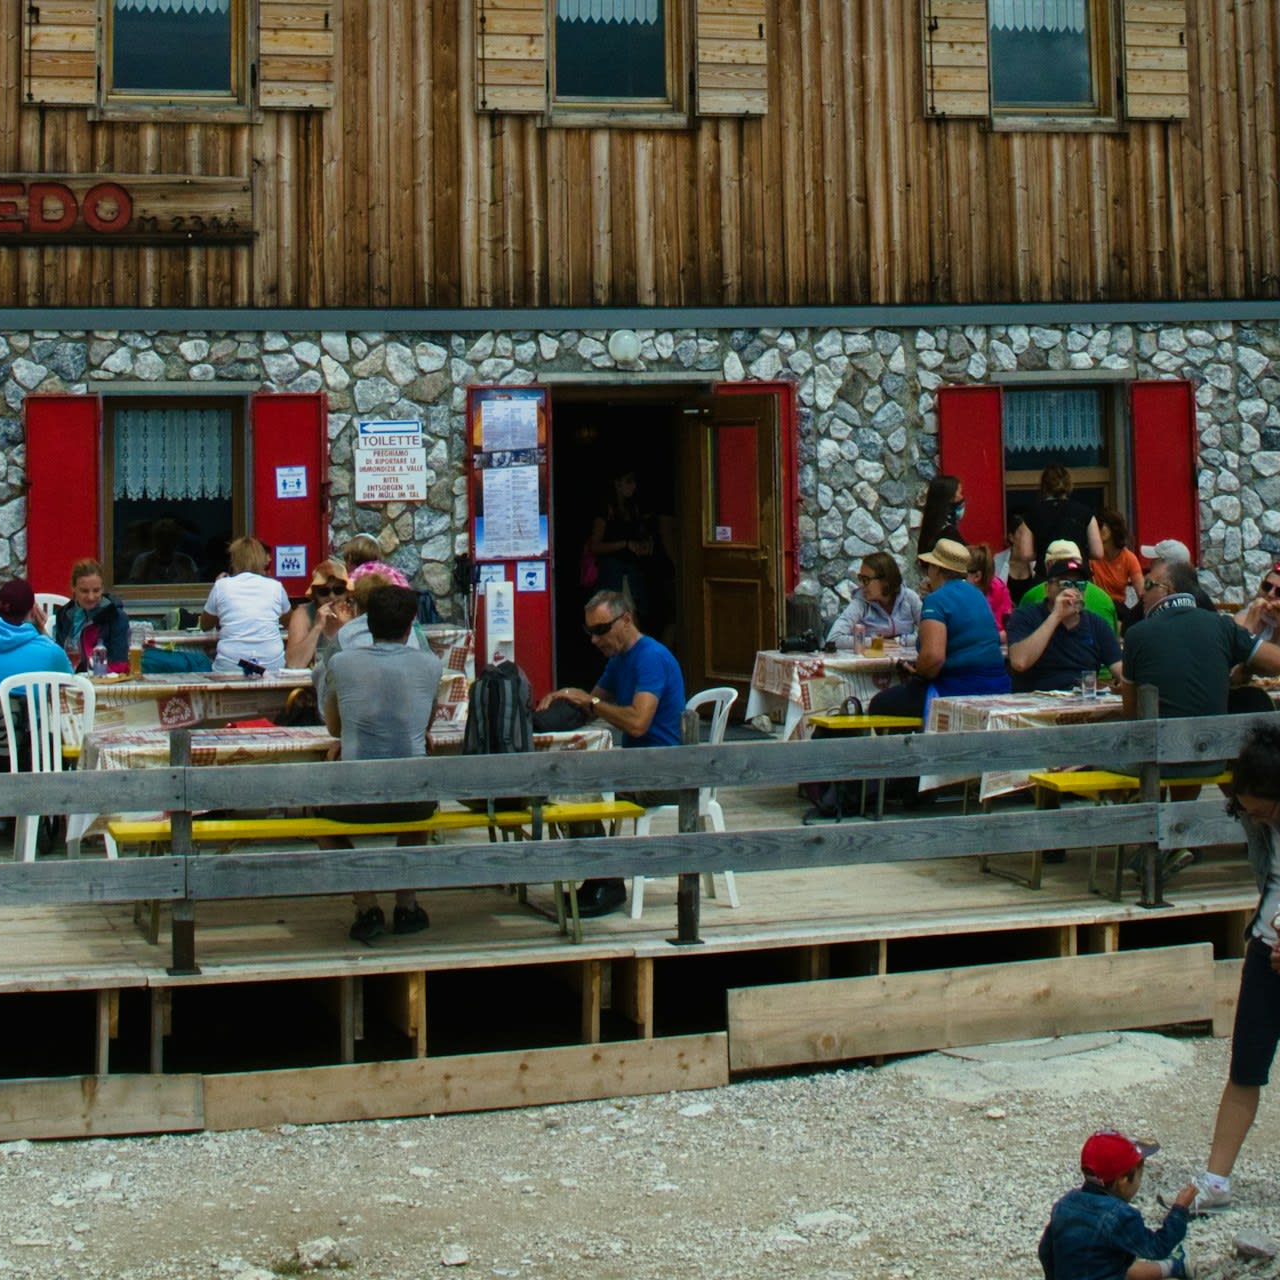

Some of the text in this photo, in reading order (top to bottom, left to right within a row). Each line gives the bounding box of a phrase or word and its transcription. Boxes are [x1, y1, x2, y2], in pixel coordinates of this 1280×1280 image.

[361, 435, 420, 446] TOILETTE
[375, 457, 407, 465] RIPORTARE
[359, 465, 396, 473] IMMONDIZIE
[406, 464, 423, 472] VALLE
[383, 476, 399, 484] BITTE
